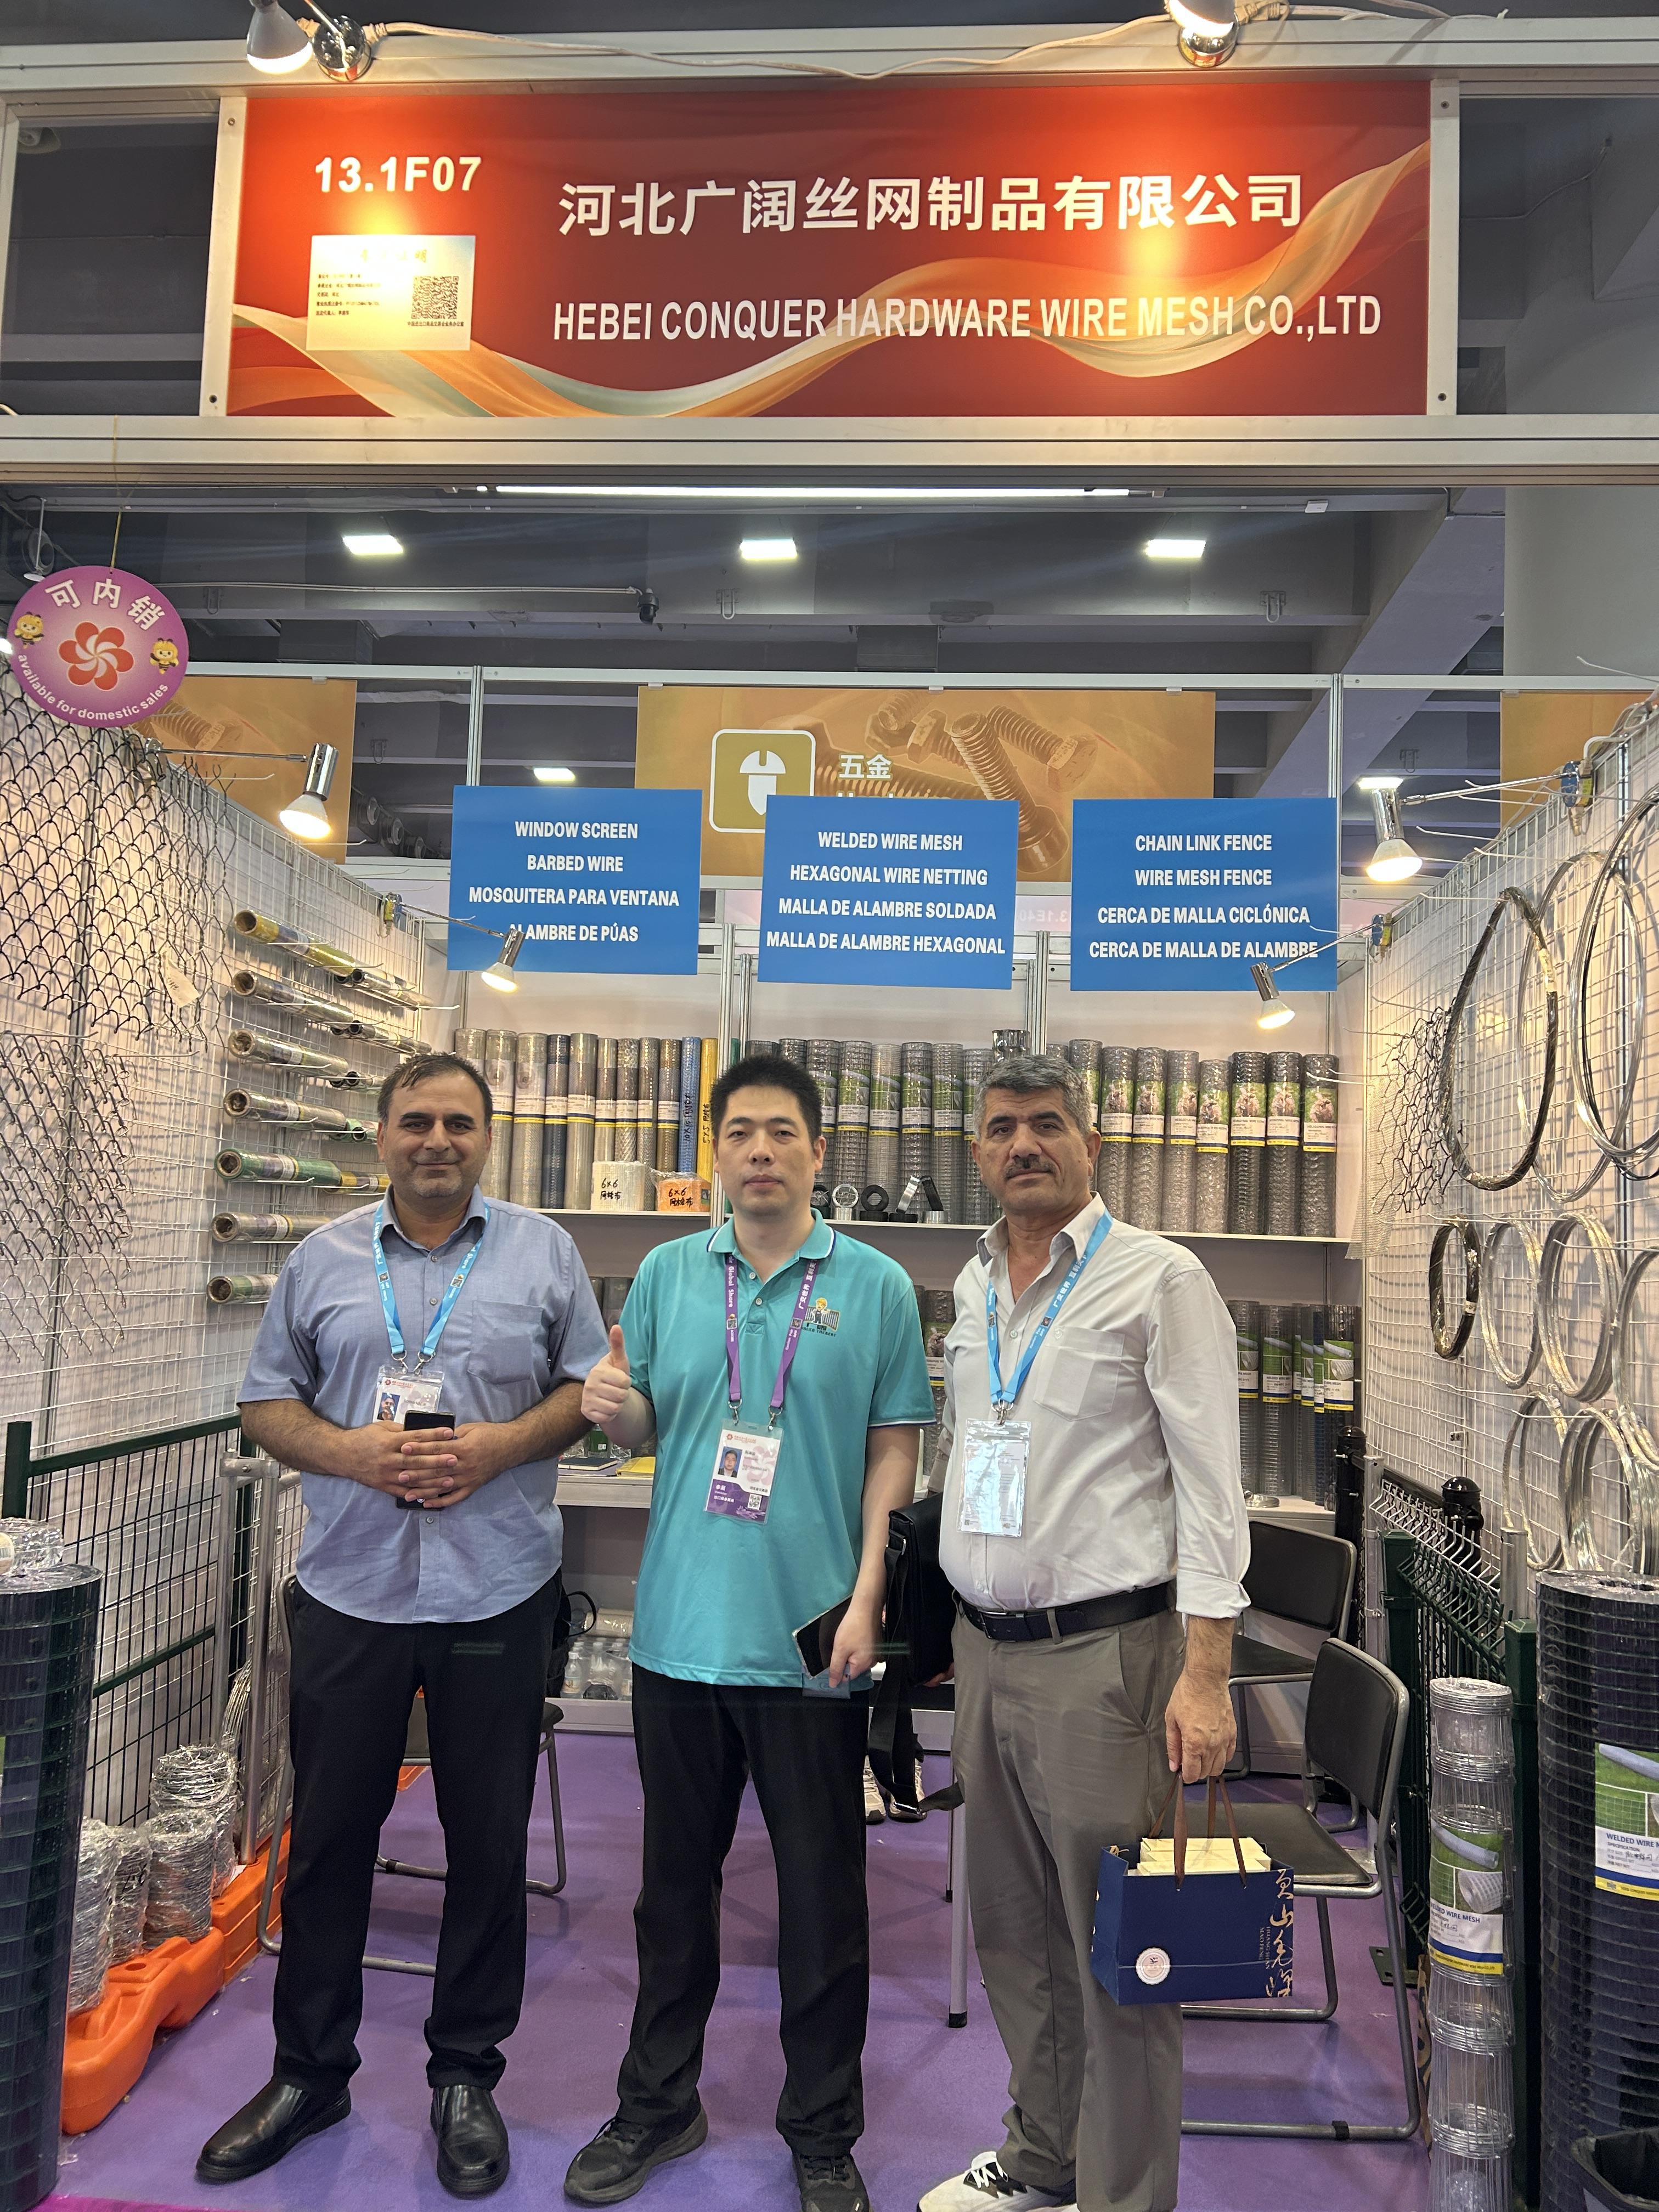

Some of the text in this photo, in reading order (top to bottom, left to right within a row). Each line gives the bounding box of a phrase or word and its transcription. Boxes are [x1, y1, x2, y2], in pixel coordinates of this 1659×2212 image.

[315, 156, 481, 193] 13.1F07
[558, 173, 1301, 236] 河北广阔丝网制品有限公司
[554, 295, 1381, 342] HEBEI CONQUER HARDWARE WIRE MESH CO.,LTD
[44, 578, 165, 630] 可内销
[18, 653, 169, 720] available for domestic sales
[839, 754, 891, 780] 五金
[515, 821, 639, 839] WINDOW SCREEN
[818, 831, 963, 851] WELDED WIRE MESH
[1135, 834, 1273, 851] CHAIN LINK FENCE
[527, 854, 624, 872] BARBED WIRE
[790, 864, 988, 885] HEXAGONAL WIRE NETTING
[1134, 869, 1273, 887] WIRE MESH FENCE
[469, 887, 680, 907] MOSQUITERA PARA VENTANA
[778, 898, 997, 920] MALLA DE ALAMBRE SOLDADA
[1097, 903, 1311, 924] CERCA DE MALLA CICLÓNICA
[580, 924, 598, 941] DE
[601, 922, 639, 942] PÚAS
[766, 931, 1006, 955] MALLA DE ALAMBRE HEXAGONAL
[1088, 940, 1319, 959] CERCA DE MALLA DE ALAMBRE
[1053, 1280, 1071, 1308] 广交世界
[1606, 1832, 1655, 1848] WELDED WIRE
[1607, 1842, 1640, 1852] SPECIFICATION
[1446, 1910, 1461, 1919] WIRE
[1463, 1915, 1480, 1923] MESH
